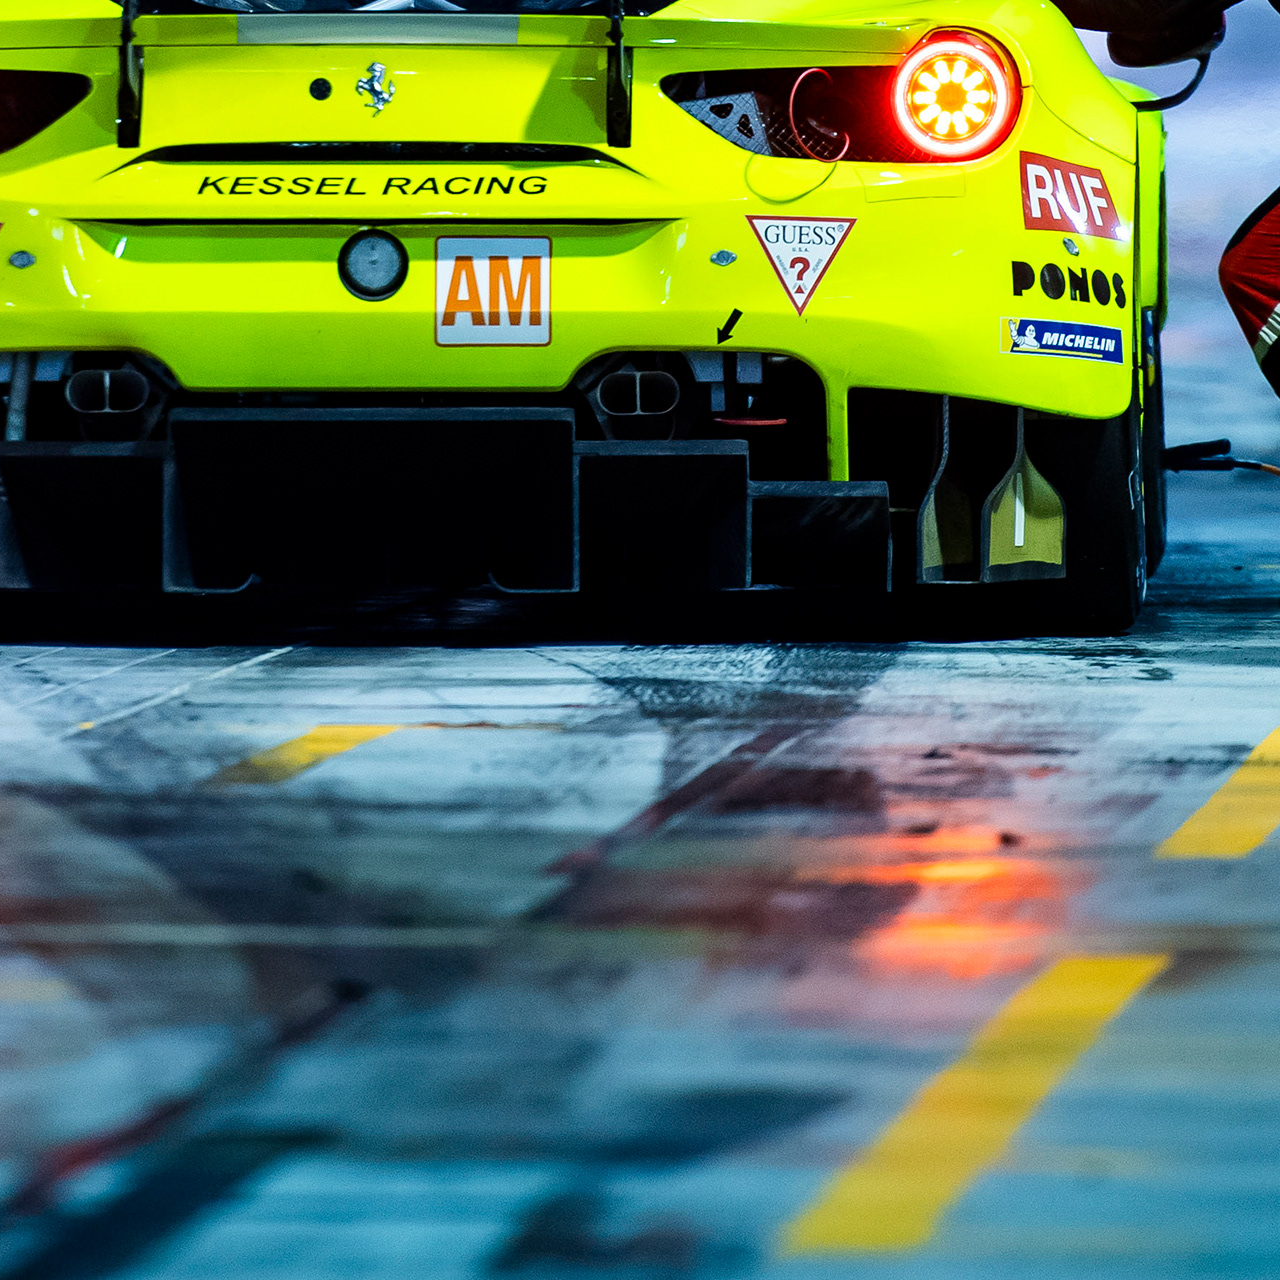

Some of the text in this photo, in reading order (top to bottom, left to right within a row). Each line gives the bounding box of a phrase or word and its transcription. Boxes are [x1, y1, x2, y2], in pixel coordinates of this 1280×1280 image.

[197, 176, 549, 196] KESSEL RACING
[1026, 163, 1109, 228] RUF
[441, 255, 543, 327] AM
[1011, 260, 1127, 309] PONOS
[1041, 331, 1116, 353] MICHELIN
